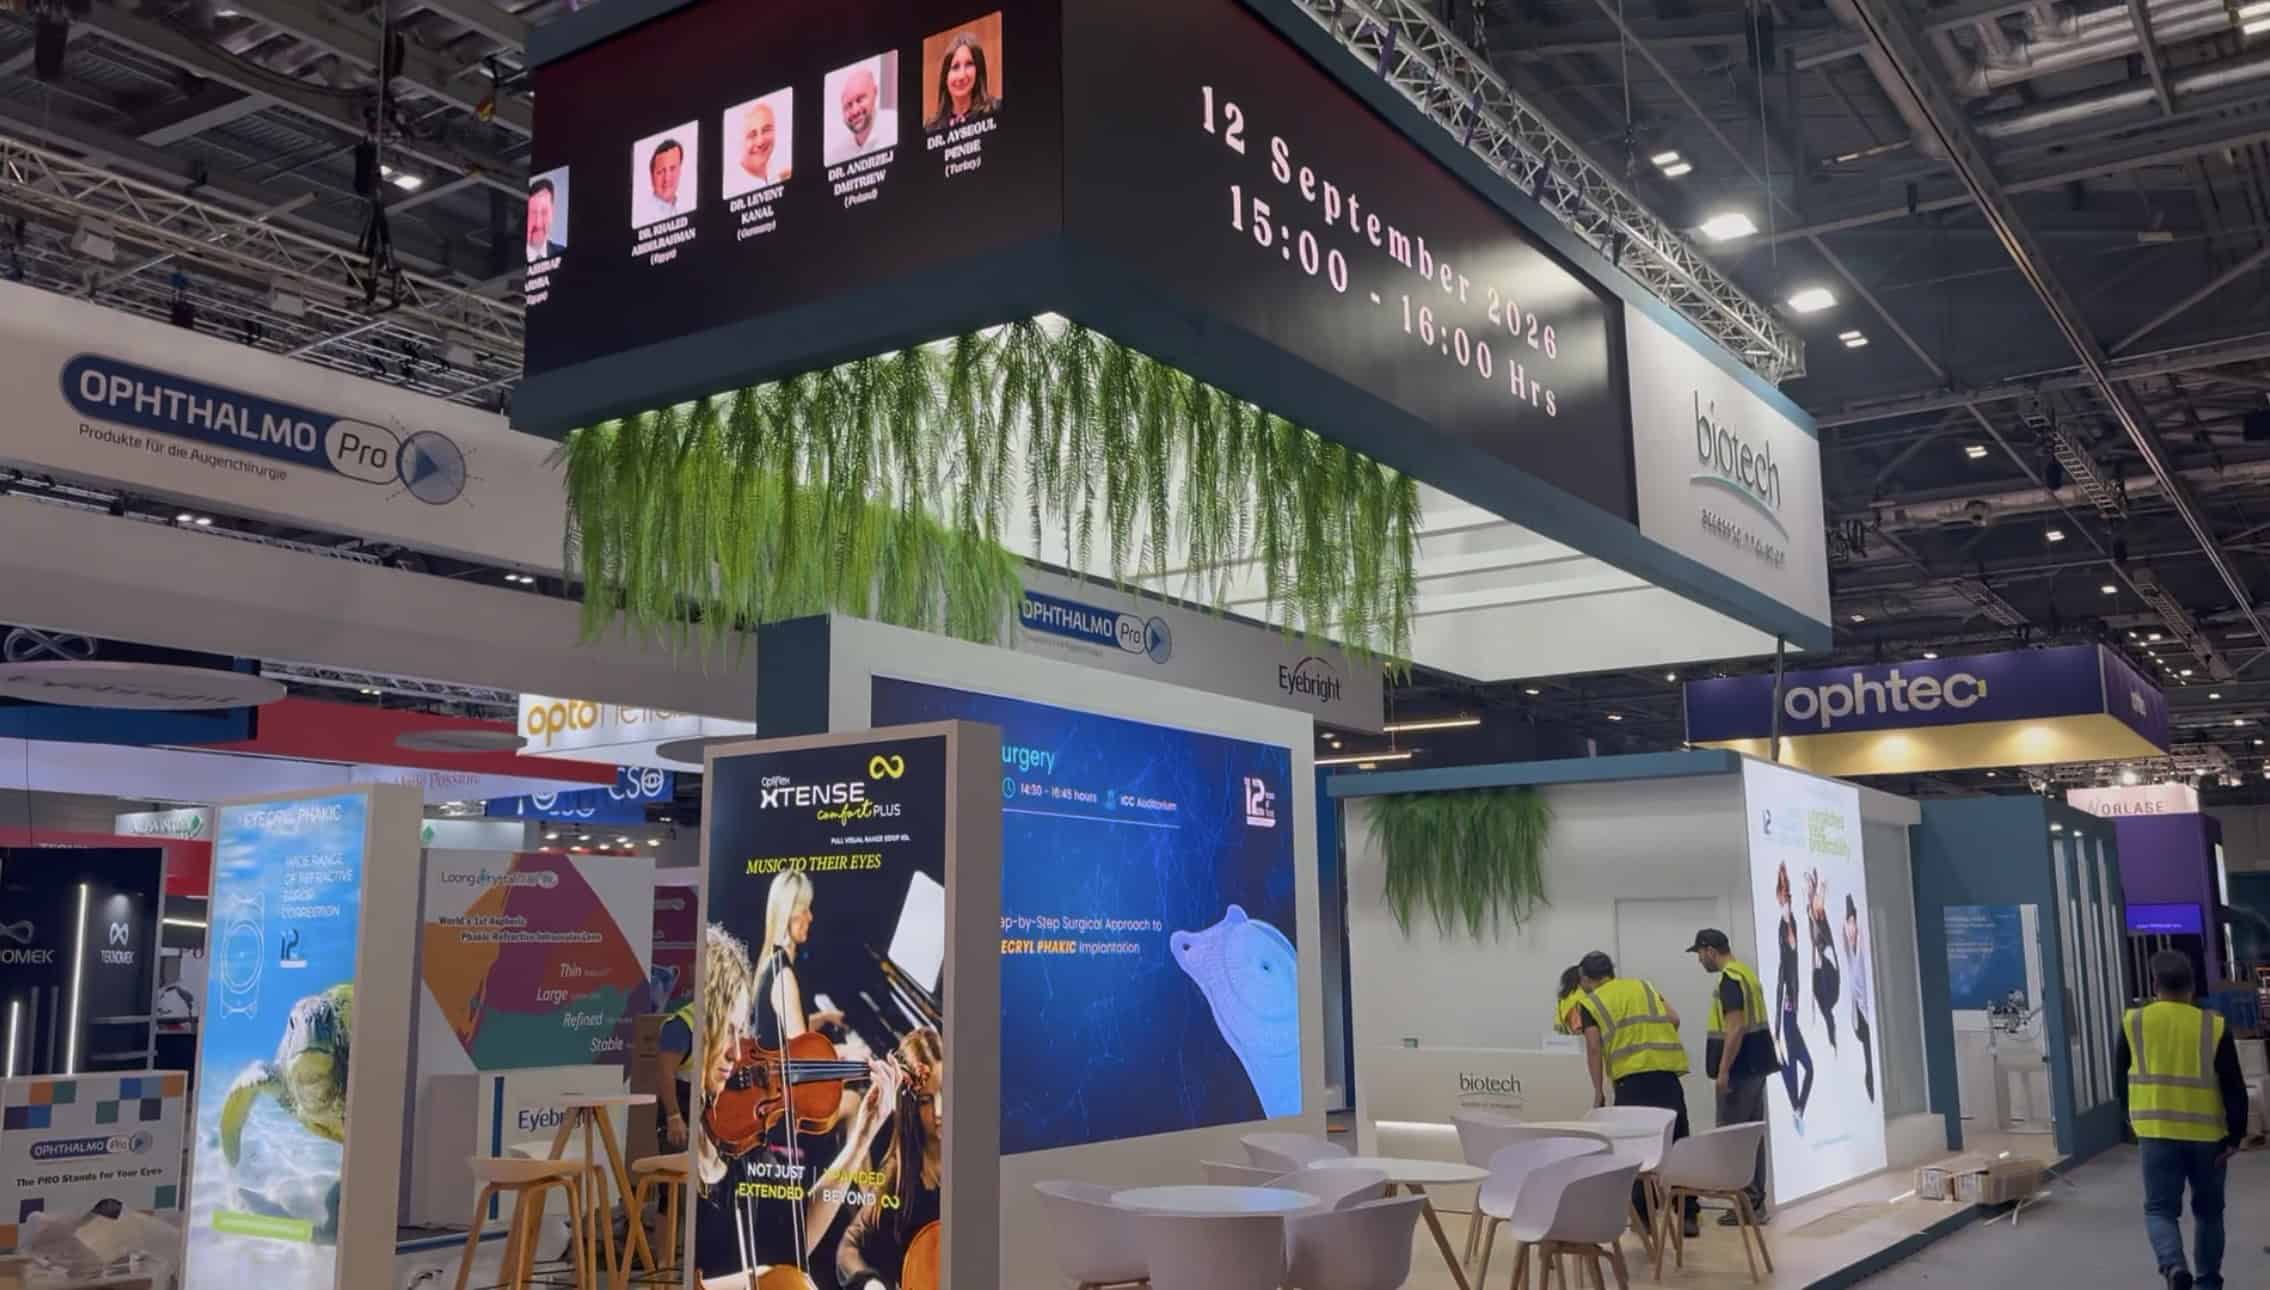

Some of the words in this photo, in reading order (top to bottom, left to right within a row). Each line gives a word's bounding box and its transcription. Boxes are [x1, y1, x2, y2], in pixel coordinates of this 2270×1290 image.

[740, 204, 775, 225] KANAL
[1201, 86, 1246, 155] 12
[1270, 136, 1470, 304] September
[1486, 287, 1557, 360] 2026
[1230, 184, 1349, 293] 15:00
[1402, 294, 1493, 380] 16:00
[1508, 358, 1557, 417] Hrs
[79, 369, 317, 452] OPHTHALMO
[337, 431, 389, 470] Pro
[79, 423, 143, 447] Produkte
[144, 438, 166, 454] für
[167, 443, 189, 459] die
[190, 448, 289, 481] Augenchirurgie
[1693, 389, 1782, 511] biotech
[1022, 598, 1113, 638] OPHTHALMO
[1120, 621, 1141, 645] Pro
[1278, 664, 1343, 703] Eyebright
[1784, 668, 1979, 729] ophtec
[759, 781, 866, 809] XTENSE
[1073, 788, 1097, 803] hours
[816, 798, 874, 827] comfort
[872, 803, 902, 818] PLUS
[745, 857, 788, 875] MUSIC
[787, 856, 807, 872] TO
[808, 855, 848, 872] THEIR
[849, 853, 882, 870] EYES
[1062, 915, 1103, 934] Surgical
[1104, 919, 1151, 935] Approach
[1151, 918, 1162, 932] to
[1036, 939, 1077, 955] PHAKIC
[1078, 941, 1140, 960] Implantation
[560, 962, 582, 977] Thin
[536, 986, 569, 1005] Large
[562, 1011, 604, 1031] Refined
[590, 1034, 624, 1052] Stable
[1459, 1071, 1521, 1093] biotech
[34, 1140, 105, 1157] OPHTHALMO
[16, 1178, 35, 1187] The
[37, 1175, 60, 1185] PRO
[62, 1173, 97, 1184] Stands
[99, 1171, 114, 1180] for
[117, 1169, 138, 1178] Your
[140, 1167, 163, 1177] Eyes
[747, 1162, 772, 1178] NOT
[774, 1164, 806, 1181] JUST
[736, 1183, 804, 1201] EXTENDED
[823, 1189, 876, 1207] BEYOND
